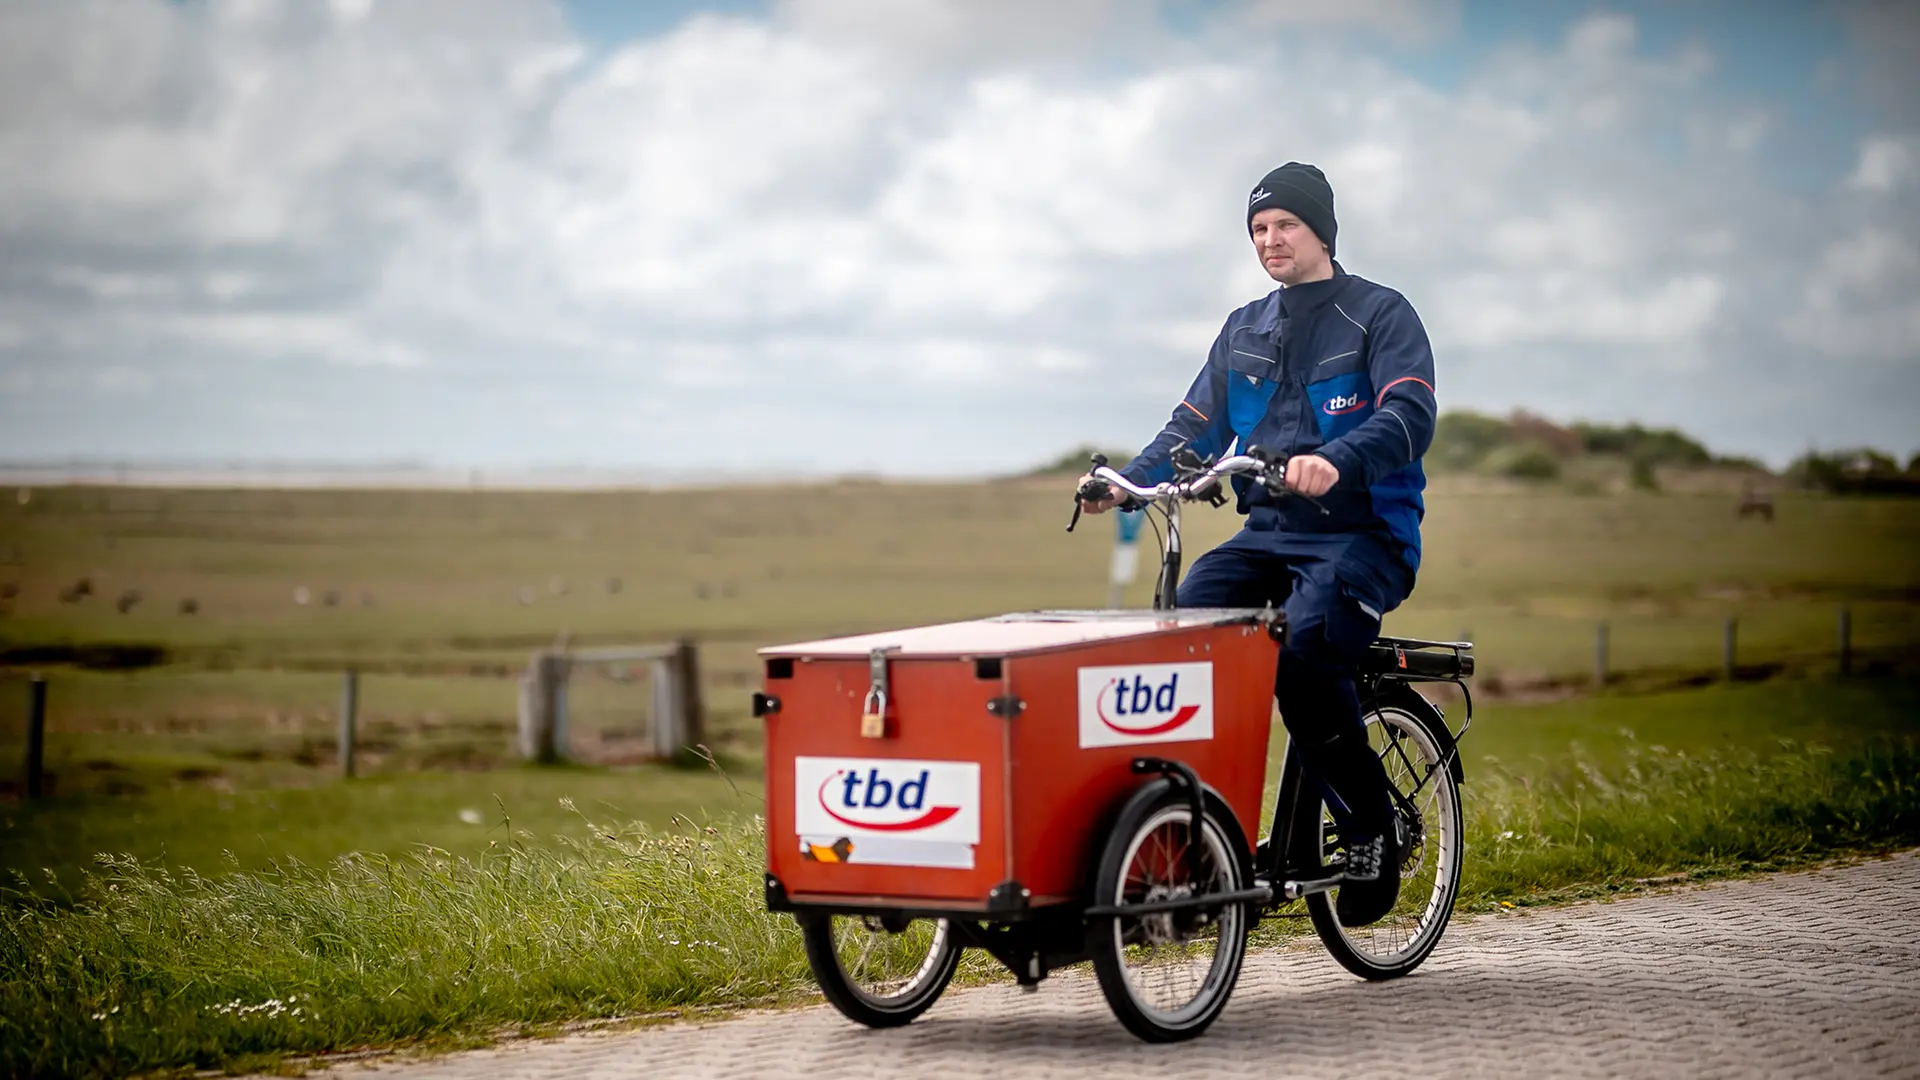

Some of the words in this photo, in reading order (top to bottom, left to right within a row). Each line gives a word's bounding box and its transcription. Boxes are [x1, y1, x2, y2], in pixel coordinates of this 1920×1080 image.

[1330, 393, 1358, 410] tbd
[1115, 672, 1179, 716] tbd
[842, 767, 930, 811] tbd
